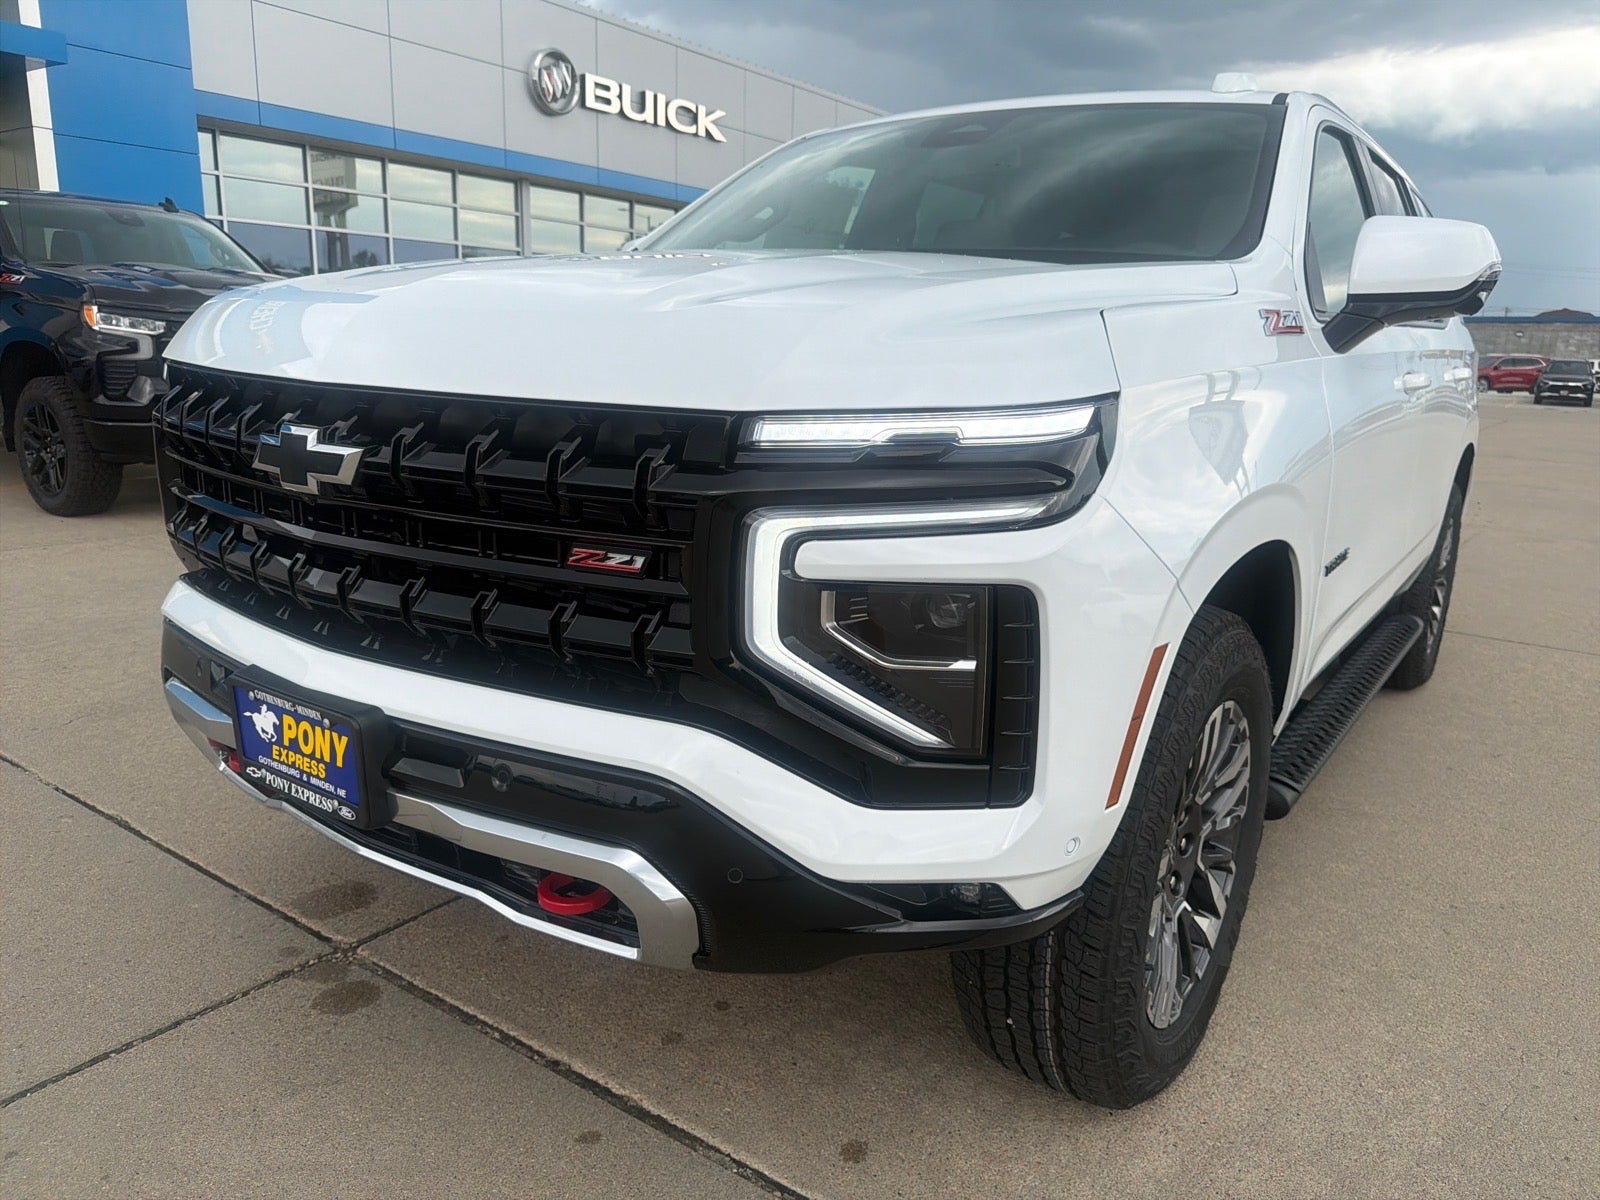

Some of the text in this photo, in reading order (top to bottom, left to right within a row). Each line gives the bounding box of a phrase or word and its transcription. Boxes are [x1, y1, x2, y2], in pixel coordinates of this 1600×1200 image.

[584, 72, 728, 143] BUICK
[1258, 308, 1305, 336] Z71
[567, 547, 646, 573] Z71
[254, 689, 322, 721] GOTHENBURG-MINDEN
[282, 713, 349, 768] PONY
[258, 755, 347, 798] GOTHENBURG & MINDEN, NE
[272, 744, 326, 779] EXPRESS
[266, 771, 333, 813] PONY EXPRESS
